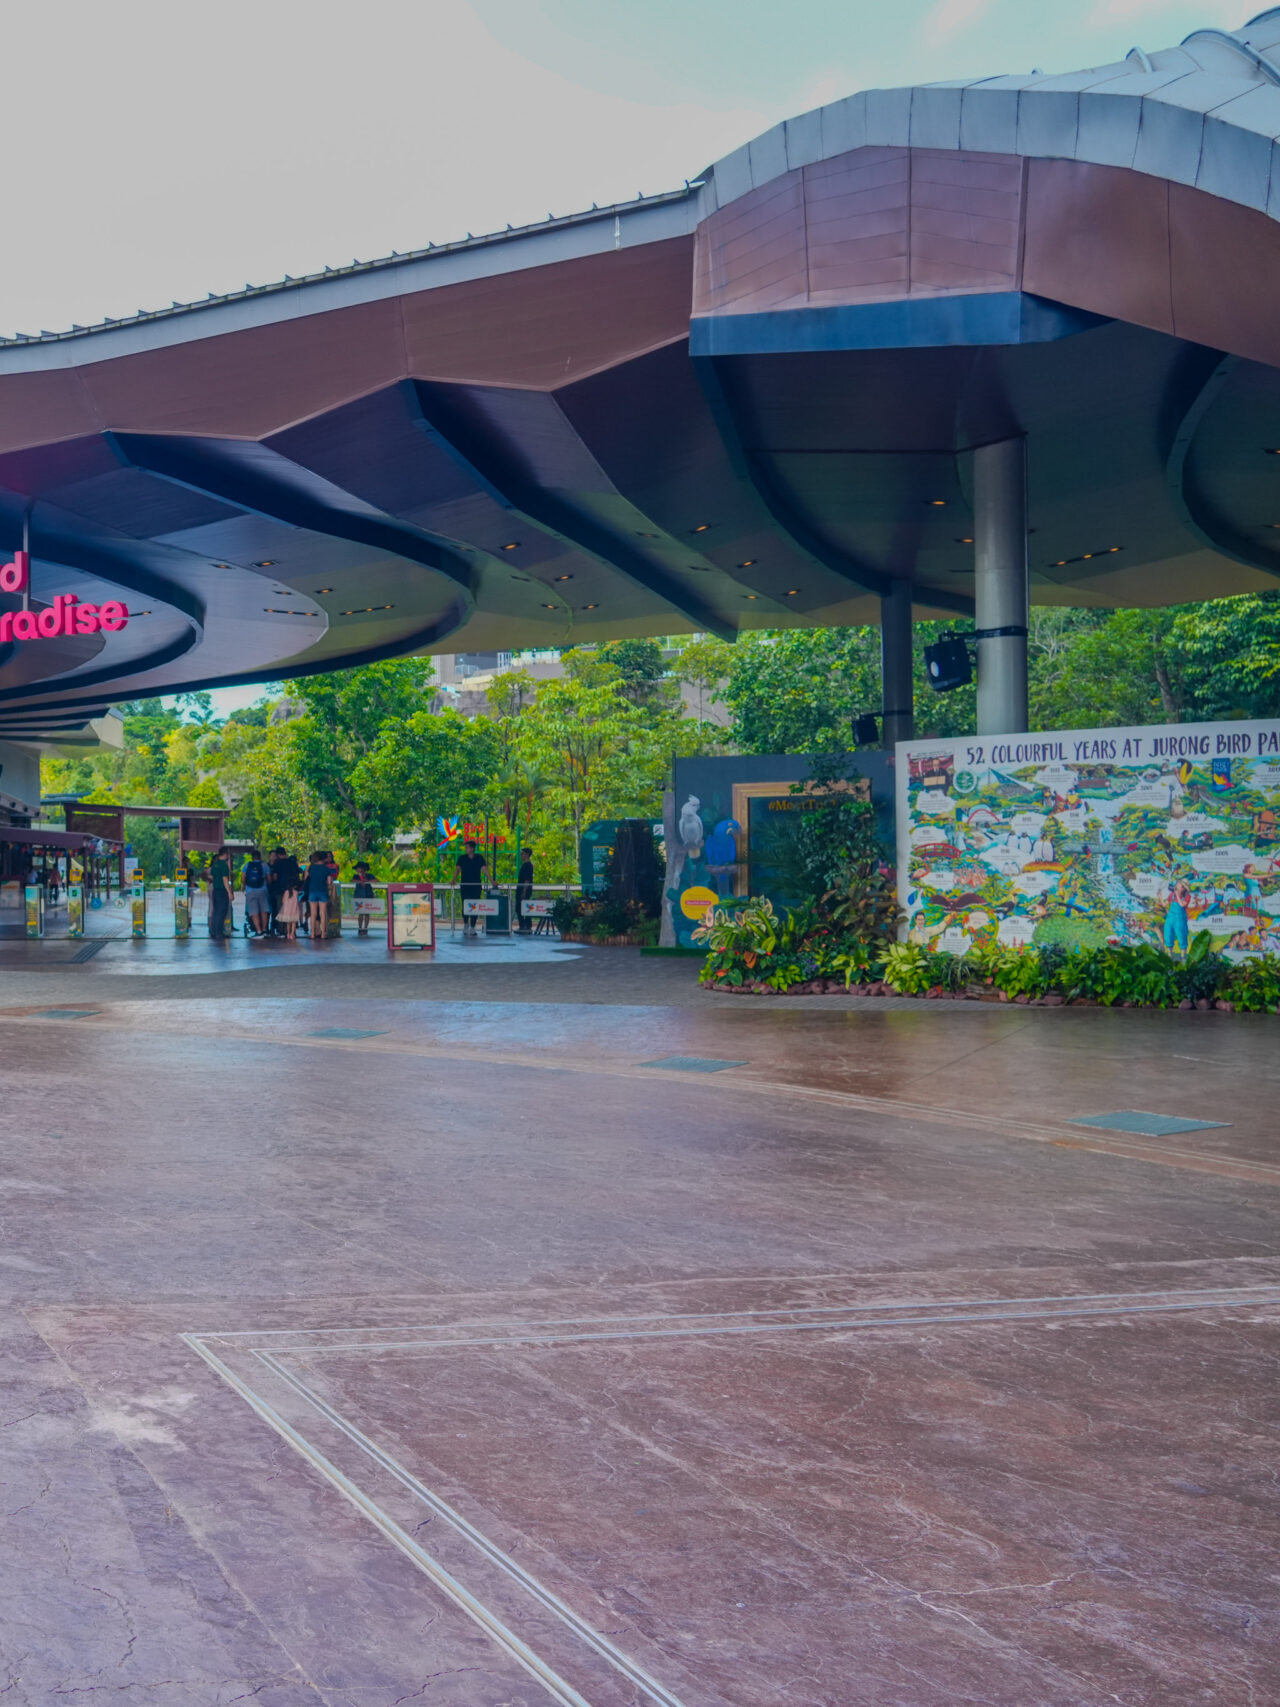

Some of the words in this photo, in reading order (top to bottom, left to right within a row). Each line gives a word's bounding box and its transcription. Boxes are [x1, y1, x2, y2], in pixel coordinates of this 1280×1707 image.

[967, 746, 985, 765] 52
[991, 741, 1068, 764] COLOURFUL
[1073, 738, 1117, 761] YEARS
[1122, 738, 1143, 758] AT
[1149, 735, 1210, 758] JURONG
[1216, 733, 1251, 754] BIRD
[1258, 731, 1280, 755] PA
[463, 822, 485, 834] Bird
